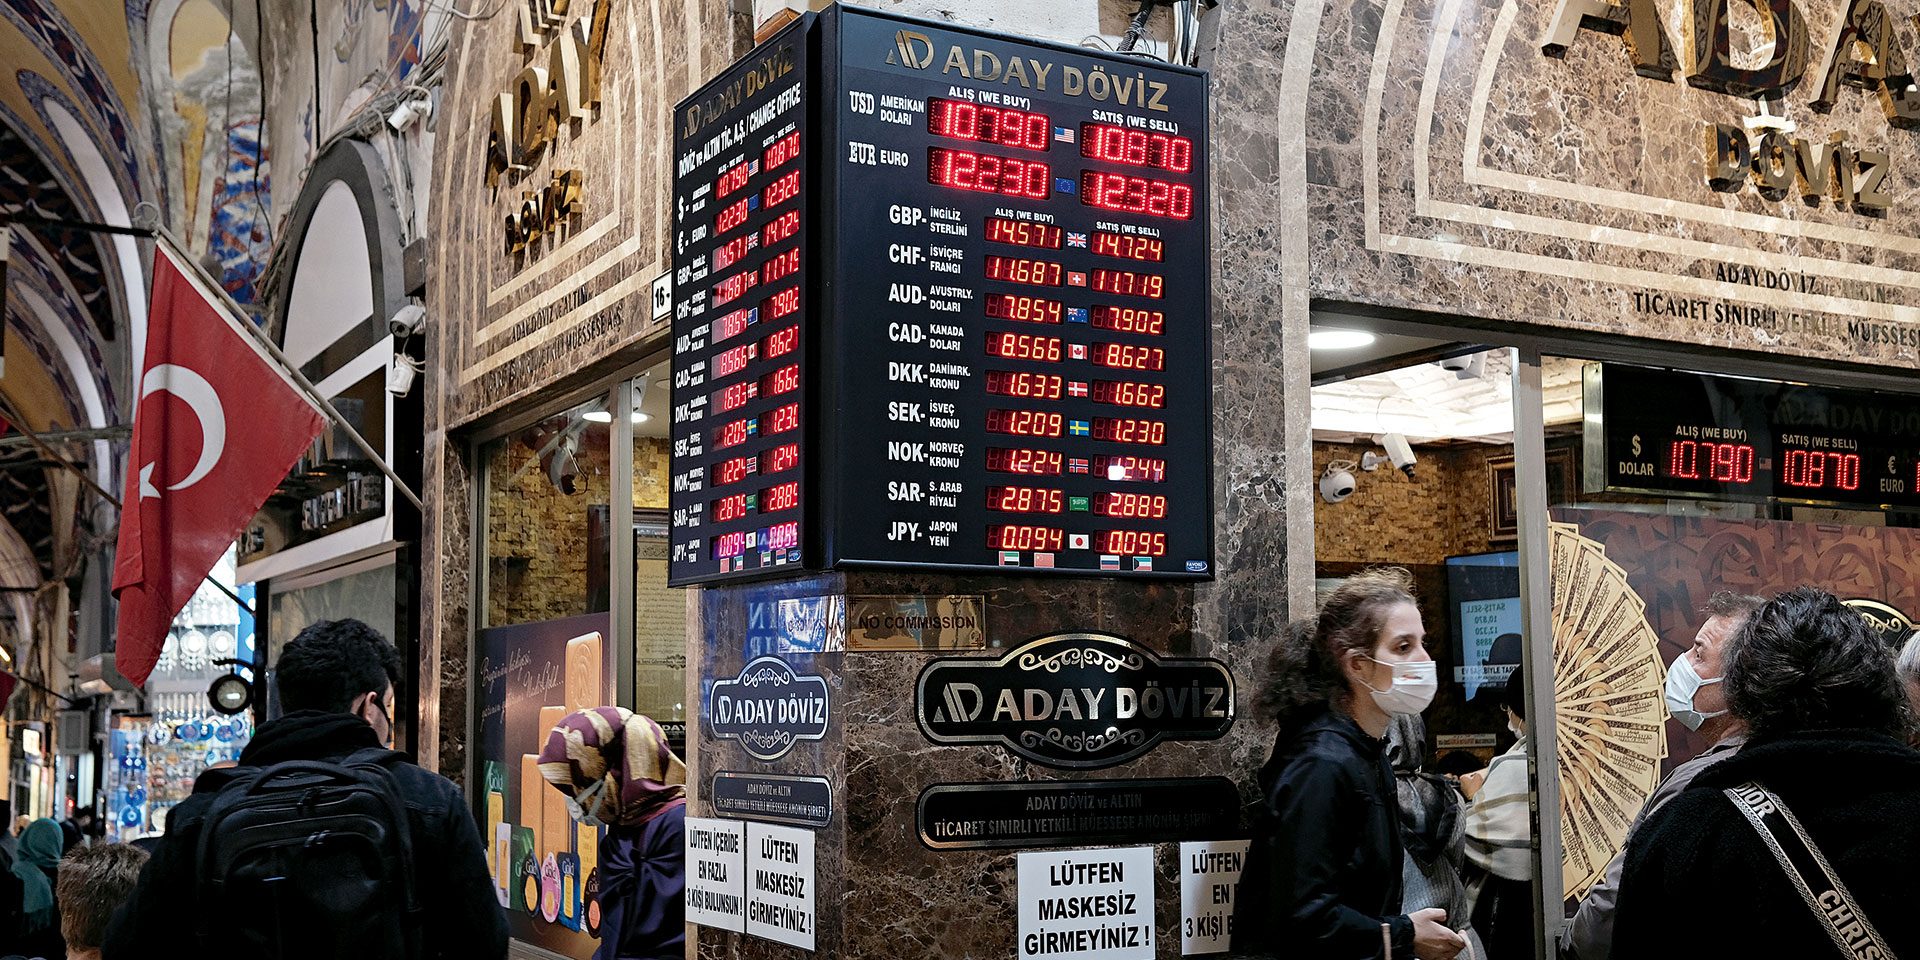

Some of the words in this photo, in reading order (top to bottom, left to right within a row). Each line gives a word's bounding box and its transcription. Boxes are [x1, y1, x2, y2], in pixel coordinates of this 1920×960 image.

[942, 45, 1053, 91] ADAY
[1063, 65, 1169, 112] DÖVİZ
[849, 90, 875, 115] USD
[880, 93, 925, 114] AMERİKAN
[948, 86, 977, 101] ALIŞ
[978, 89, 1001, 105] (WE
[1003, 94, 1031, 111] BUY)
[703, 134, 721, 164] ALTIN
[749, 100, 776, 133] CHANGE
[777, 82, 801, 112] OFFICE
[880, 110, 912, 127] DOLARI
[1092, 109, 1124, 126] SATIŞ
[1126, 114, 1147, 130] (WE
[1149, 118, 1179, 135] SELL)
[849, 141, 877, 167] EUR
[880, 150, 909, 168] EURO
[1704, 95, 1893, 219] DÖVİZ
[889, 204, 927, 227] GBP-
[929, 205, 961, 221] İNGİLİZ
[995, 208, 1014, 219] ALIŞ
[1016, 209, 1032, 222] (WE
[1034, 212, 1055, 225] BUY)
[929, 221, 968, 237] STERLİNİ
[1096, 221, 1119, 233] SATIŞ
[1121, 223, 1136, 235] (WE
[1138, 225, 1160, 238] SELL)
[889, 244, 926, 265] CHF-
[929, 244, 963, 261] İSVİÇRE
[929, 260, 960, 275] FRANGI
[1716, 262, 1762, 287] ADAY
[888, 283, 927, 305] AUD-
[929, 285, 973, 301] AVUSTRLY.
[929, 300, 961, 314] DOLARI
[1633, 289, 1710, 323] TİCARET
[888, 322, 926, 344] CAD-
[929, 323, 964, 338] KANADA
[929, 338, 960, 352] DOLARI
[888, 361, 928, 383] DKK-
[929, 361, 971, 377] DANİMRK.
[929, 377, 960, 391] KRONU
[888, 402, 926, 422] SEK-
[929, 400, 955, 416] İSVEÇ
[929, 417, 960, 430] KRONU
[1676, 425, 1699, 440] ALIŞ
[1701, 427, 1721, 440] (WE
[1723, 428, 1747, 442] BUY)
[888, 442, 929, 462] NOK-
[929, 441, 964, 458] NORVEÇ
[1632, 434, 1642, 458] $
[1782, 433, 1809, 448] SATIŞ
[1812, 436, 1830, 450] (WE
[1832, 438, 1858, 451] SELL)
[929, 456, 960, 469] KRONU
[1619, 461, 1654, 476] DOLAR
[887, 481, 926, 502] SAR-
[929, 481, 938, 493] S.
[939, 482, 962, 494] ARAB
[1880, 478, 1905, 493] EURO
[929, 493, 957, 508] RİYALİ
[887, 521, 922, 542] JPY-
[929, 520, 958, 534] JAPON
[929, 534, 950, 548] YENİ
[860, 617, 879, 629] NO
[885, 616, 975, 629] COMMISSION
[734, 699, 775, 724] ADAY
[778, 692, 824, 724] DÖVİZ
[992, 687, 1106, 721] ADAY
[1116, 680, 1225, 720] DÖVİZ
[1026, 795, 1057, 812] ADAY
[1060, 791, 1095, 810] DÖVİZ
[934, 818, 985, 837] TİCARET
[988, 817, 1031, 835] SINIRLI
[1034, 815, 1076, 834] YETKİLİ
[690, 826, 713, 851] LÜTFEN
[713, 827, 739, 856] İÇERİDE
[762, 834, 798, 864] LÜTFEN
[698, 860, 707, 880] EN
[707, 861, 727, 883] FAZLA
[1192, 849, 1241, 875] LÜTFEN
[1050, 860, 1124, 887] LÜTFEN
[756, 869, 805, 900] MASKESİZ
[1212, 884, 1230, 904] EN
[692, 885, 704, 914] KİŞİ
[705, 888, 739, 915] BULUNSUN
[1038, 889, 1137, 921] MASKESİZ
[749, 897, 805, 933] GİRMEYİNİZ
[1818, 889, 1889, 960] CHRIS
[1185, 917, 1193, 938] 3
[1197, 911, 1223, 941] KİŞİ
[1024, 922, 1140, 955] GİRMEYİNİZ
